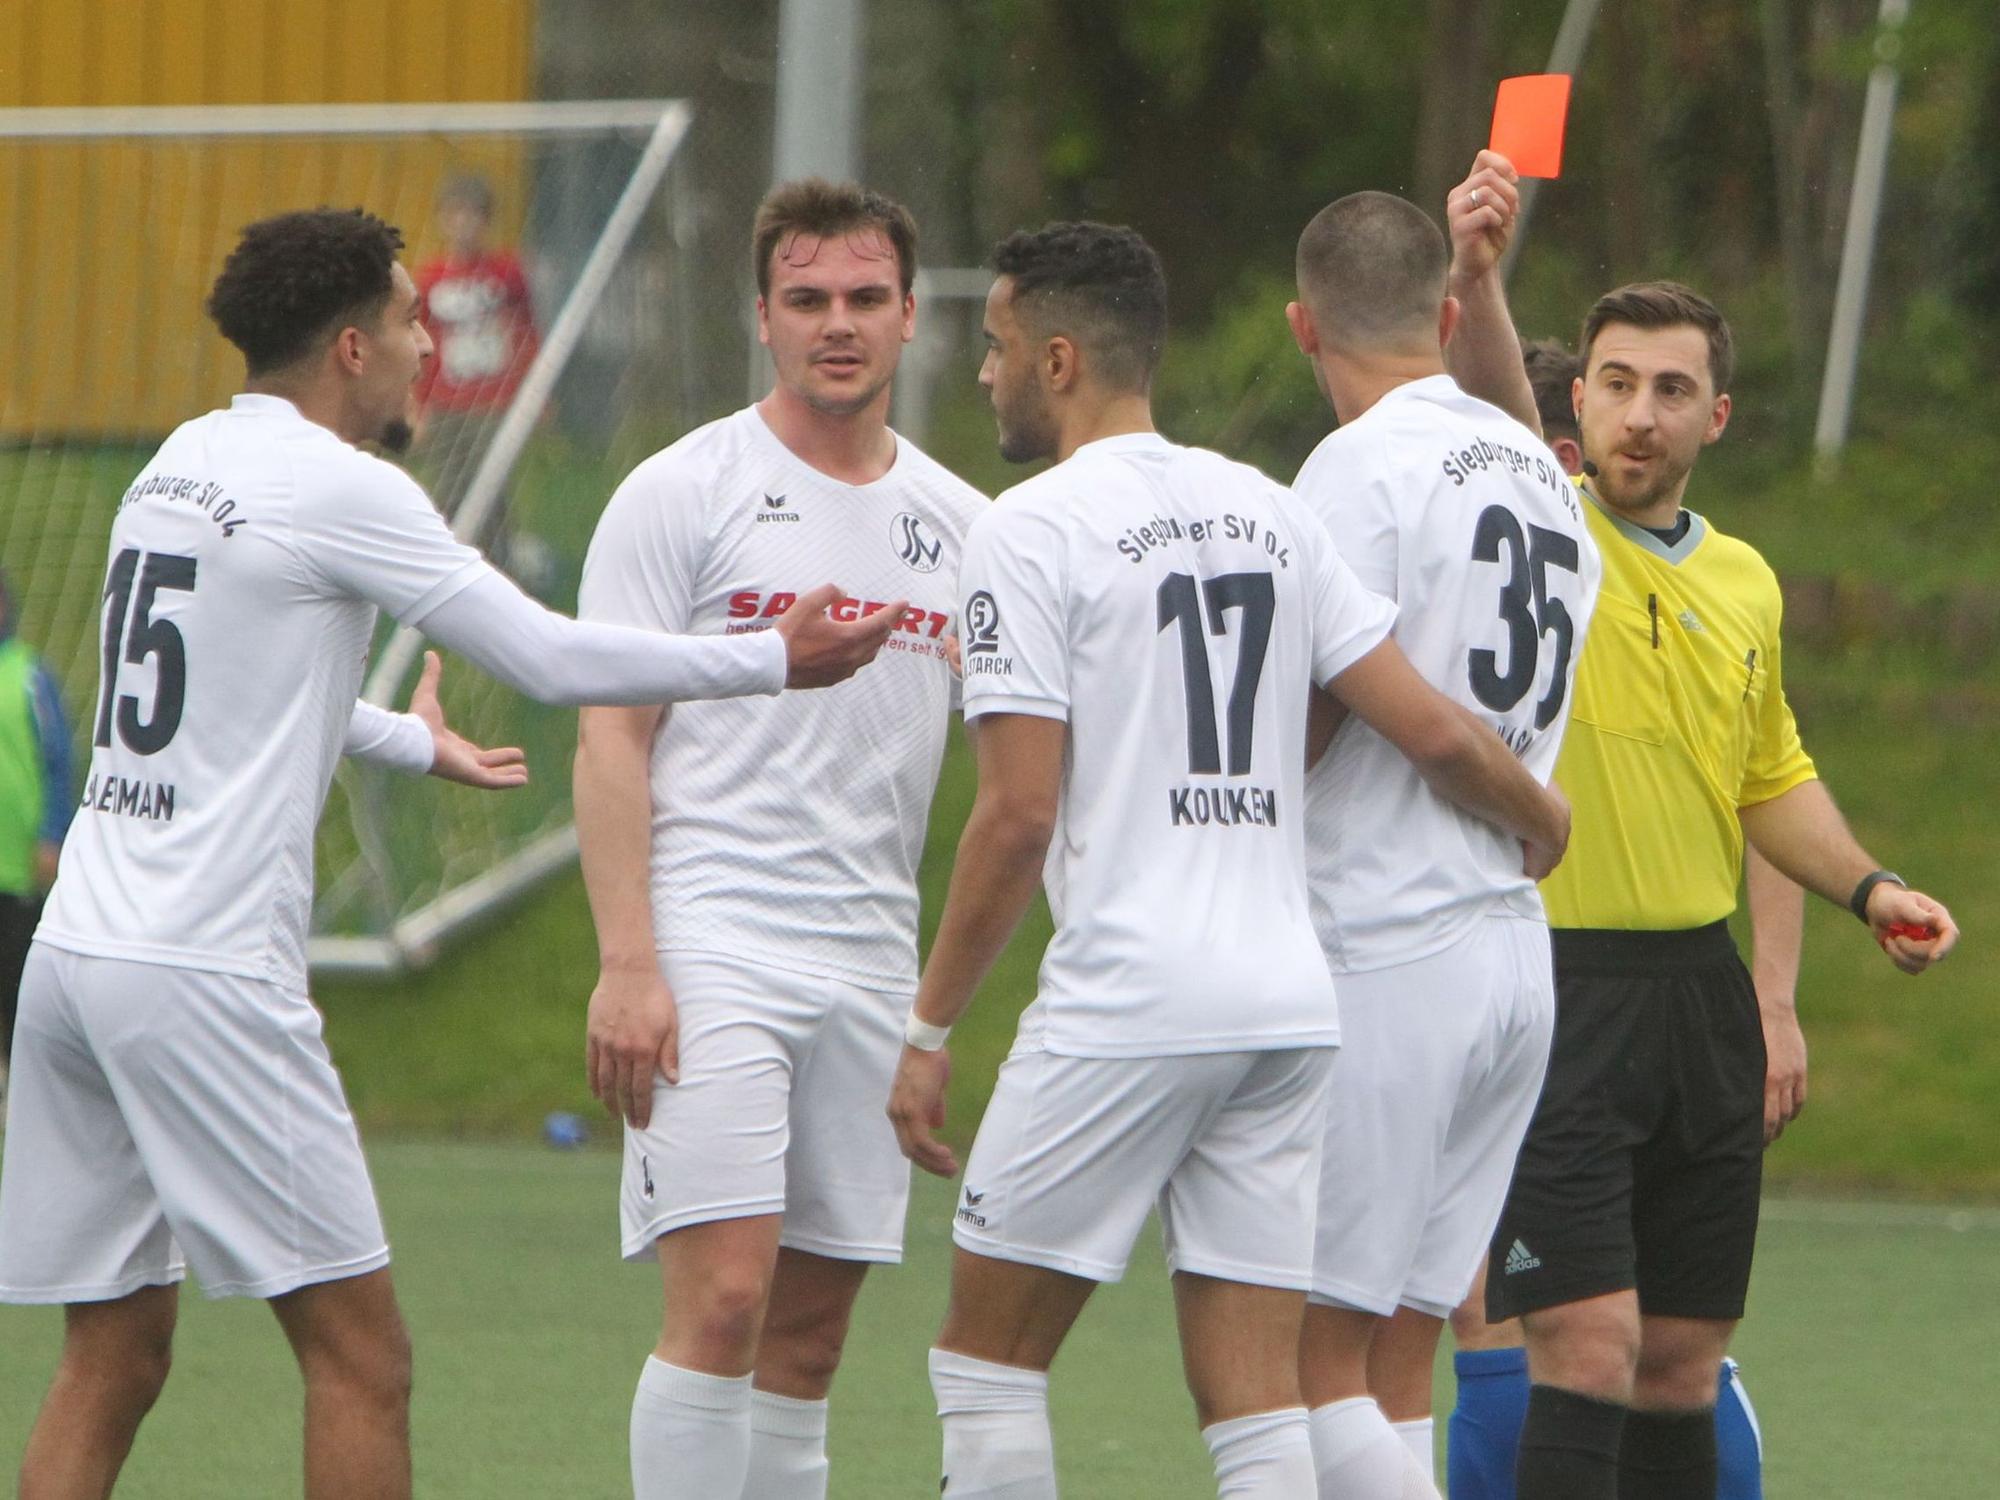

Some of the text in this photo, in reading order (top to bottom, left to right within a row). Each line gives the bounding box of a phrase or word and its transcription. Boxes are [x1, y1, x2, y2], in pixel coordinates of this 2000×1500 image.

[1443, 437, 1530, 485] Siegburger
[1536, 458, 1556, 491] SV
[117, 472, 247, 538] iegburger SV 04
[757, 511, 800, 522] erima
[1223, 513, 1256, 543] SV
[1265, 530, 1289, 569] 04
[1468, 504, 1578, 732] 35
[94, 549, 197, 756] 15
[968, 657, 1012, 676] STARCK
[1157, 572, 1276, 776] 17
[1169, 787, 1277, 827] KOUKEN
[1504, 1257, 1542, 1275] adidas
